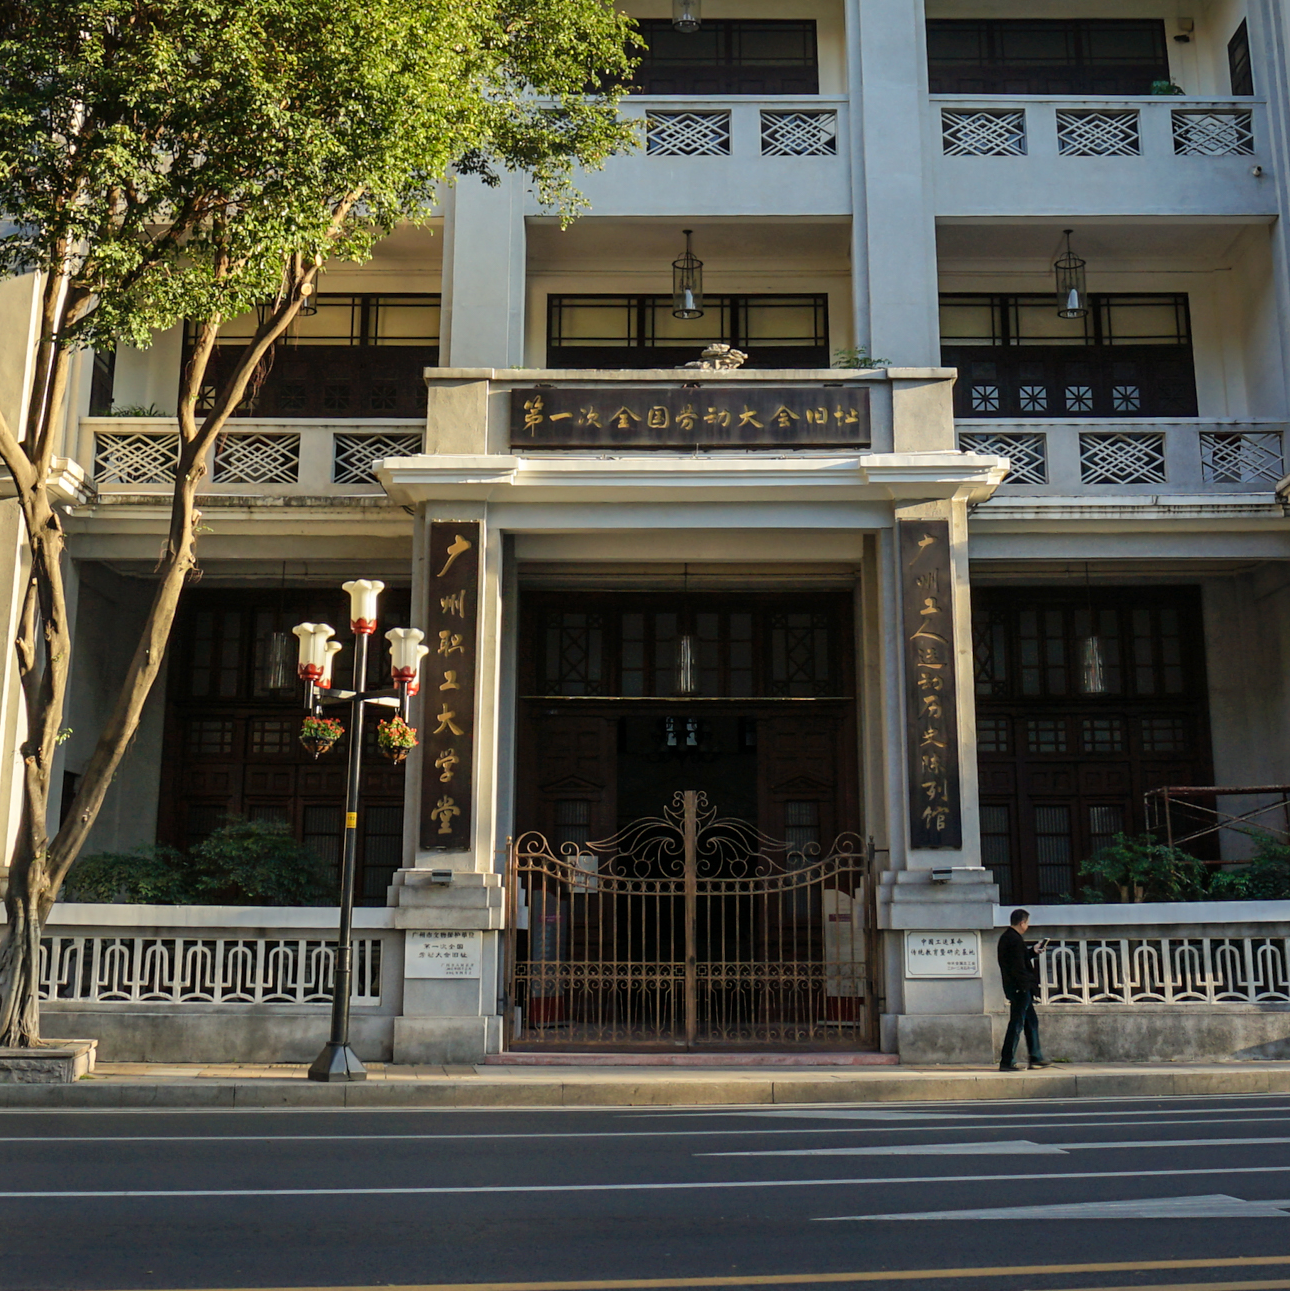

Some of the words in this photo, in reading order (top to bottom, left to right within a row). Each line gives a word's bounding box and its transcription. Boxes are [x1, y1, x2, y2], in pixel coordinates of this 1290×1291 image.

[522, 394, 859, 437] 第一次全国劳动大会旧址
[430, 534, 472, 835] 广州职工大学堂
[909, 533, 949, 832] 广州工人运动历史陈列馆
[412, 931, 475, 939] 广州市文物保护单位
